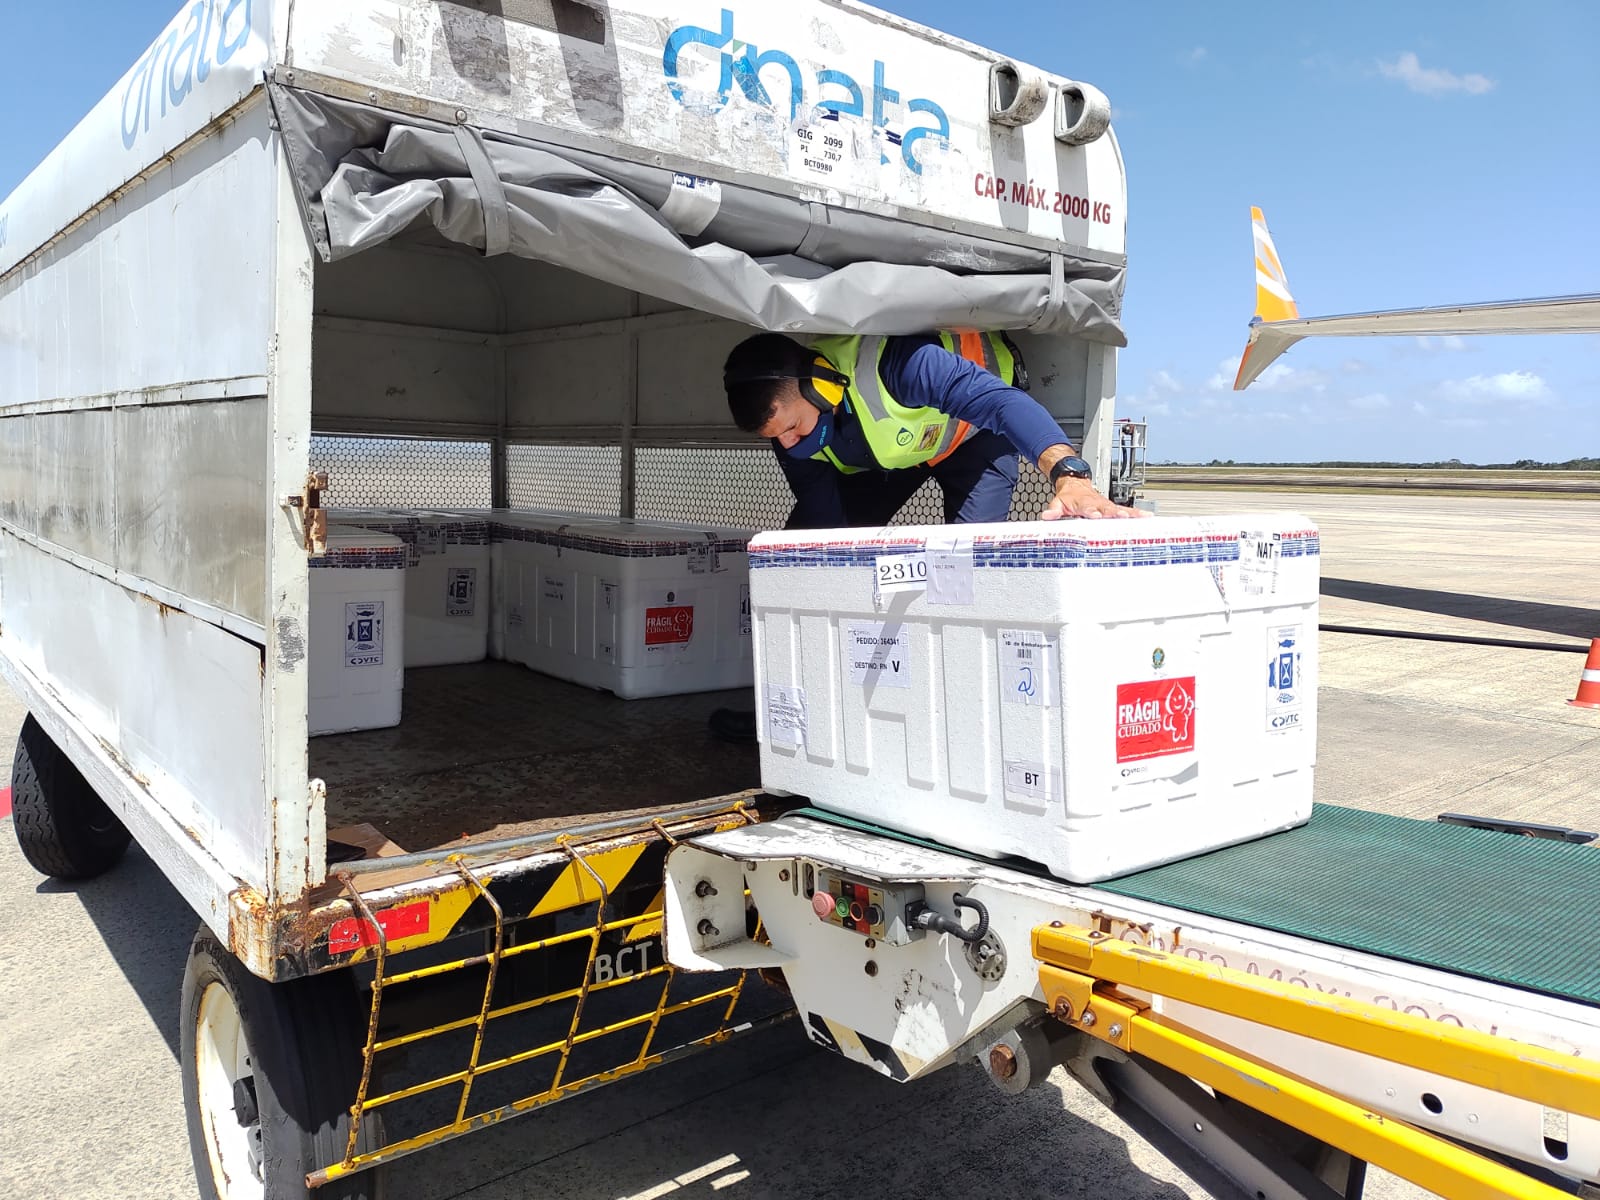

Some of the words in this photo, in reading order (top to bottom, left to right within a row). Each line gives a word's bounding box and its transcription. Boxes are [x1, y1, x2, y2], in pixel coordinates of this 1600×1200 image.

[797, 128, 813, 140] GIG
[824, 135, 843, 149] 2099
[975, 173, 1007, 201] CAP.
[1012, 178, 1049, 211] MÁX.
[1053, 191, 1090, 219] 2000
[1093, 201, 1111, 224] KG
[1257, 541, 1274, 559] NAT
[880, 561, 927, 581] 2310
[892, 660, 900, 673] V
[1119, 698, 1160, 725] FRÁGIL
[1118, 721, 1161, 738] CUIDADO
[1025, 772, 1039, 786] BT
[595, 941, 653, 984] BCT
